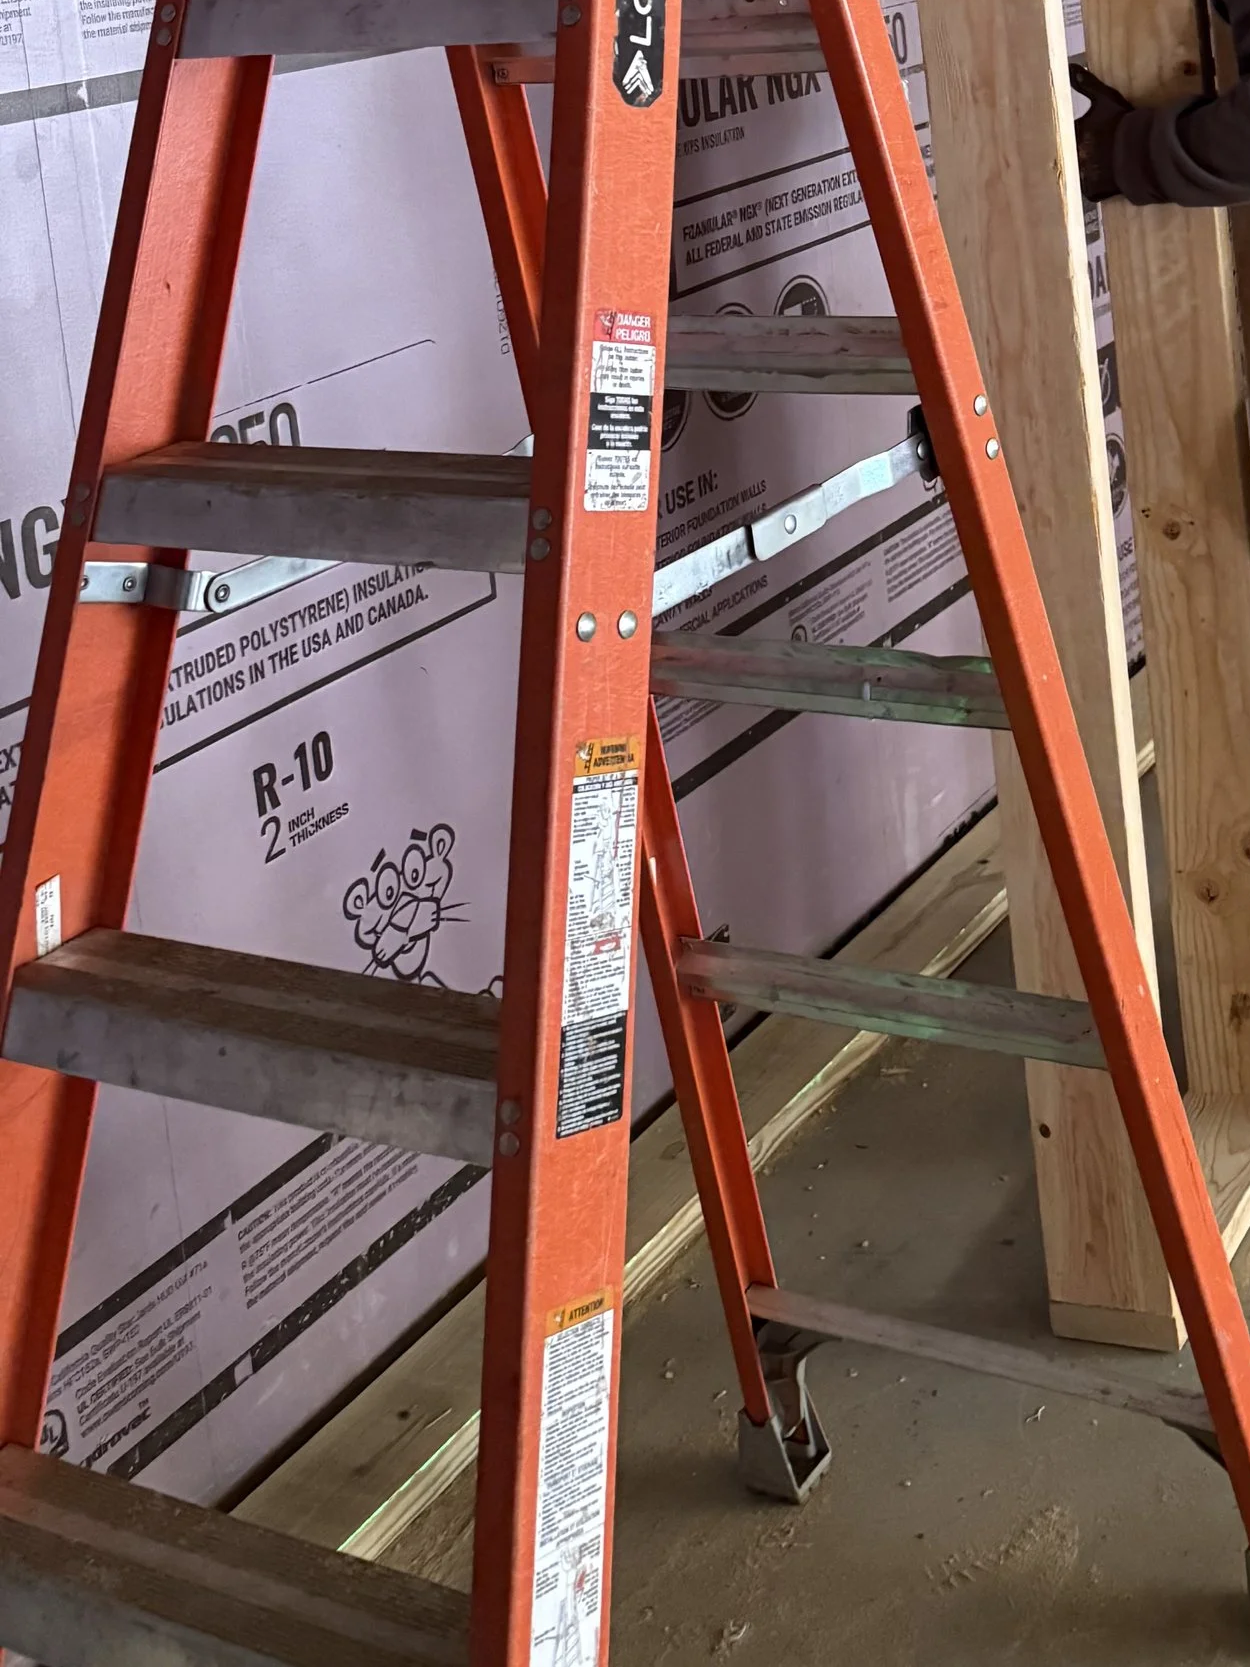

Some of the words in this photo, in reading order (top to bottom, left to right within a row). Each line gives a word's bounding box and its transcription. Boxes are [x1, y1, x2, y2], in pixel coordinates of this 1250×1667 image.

[79, 0, 93, 11] the
[82, 28, 97, 40] the
[677, 74, 759, 128] ULAR
[700, 125, 746, 152] INSULATION
[764, 193, 790, 218] (NEXT
[790, 173, 842, 206] GENERATION
[842, 168, 858, 190] EXT
[685, 245, 705, 267] ALL
[704, 234, 745, 262] FEDERAL
[745, 224, 764, 246] AND
[764, 214, 793, 238] STATE
[793, 202, 834, 229] EMISSION
[615, 327, 652, 344] PELIGRO
[616, 313, 652, 329] DANGER
[664, 484, 696, 516] USE
[698, 469, 719, 499] IN:
[686, 494, 741, 533] FOUNDATION
[711, 574, 769, 620] APPLICATIONS
[166, 642, 236, 693] TRUDED
[239, 587, 351, 655] POLYSTYRENE)
[352, 561, 428, 605] INSULATI
[160, 669, 246, 729] ULATIONS
[248, 660, 267, 686] IN
[267, 645, 300, 676] THE
[301, 628, 333, 660] USA
[334, 612, 366, 644] AND
[366, 583, 430, 628] CANADA.
[252, 730, 335, 818] R-10
[592, 754, 635, 769] ADVERTENIA
[259, 815, 288, 865] 2
[287, 807, 316, 835] INCH
[289, 802, 351, 848] THICKNESS
[568, 1297, 605, 1322] ATTENTION
